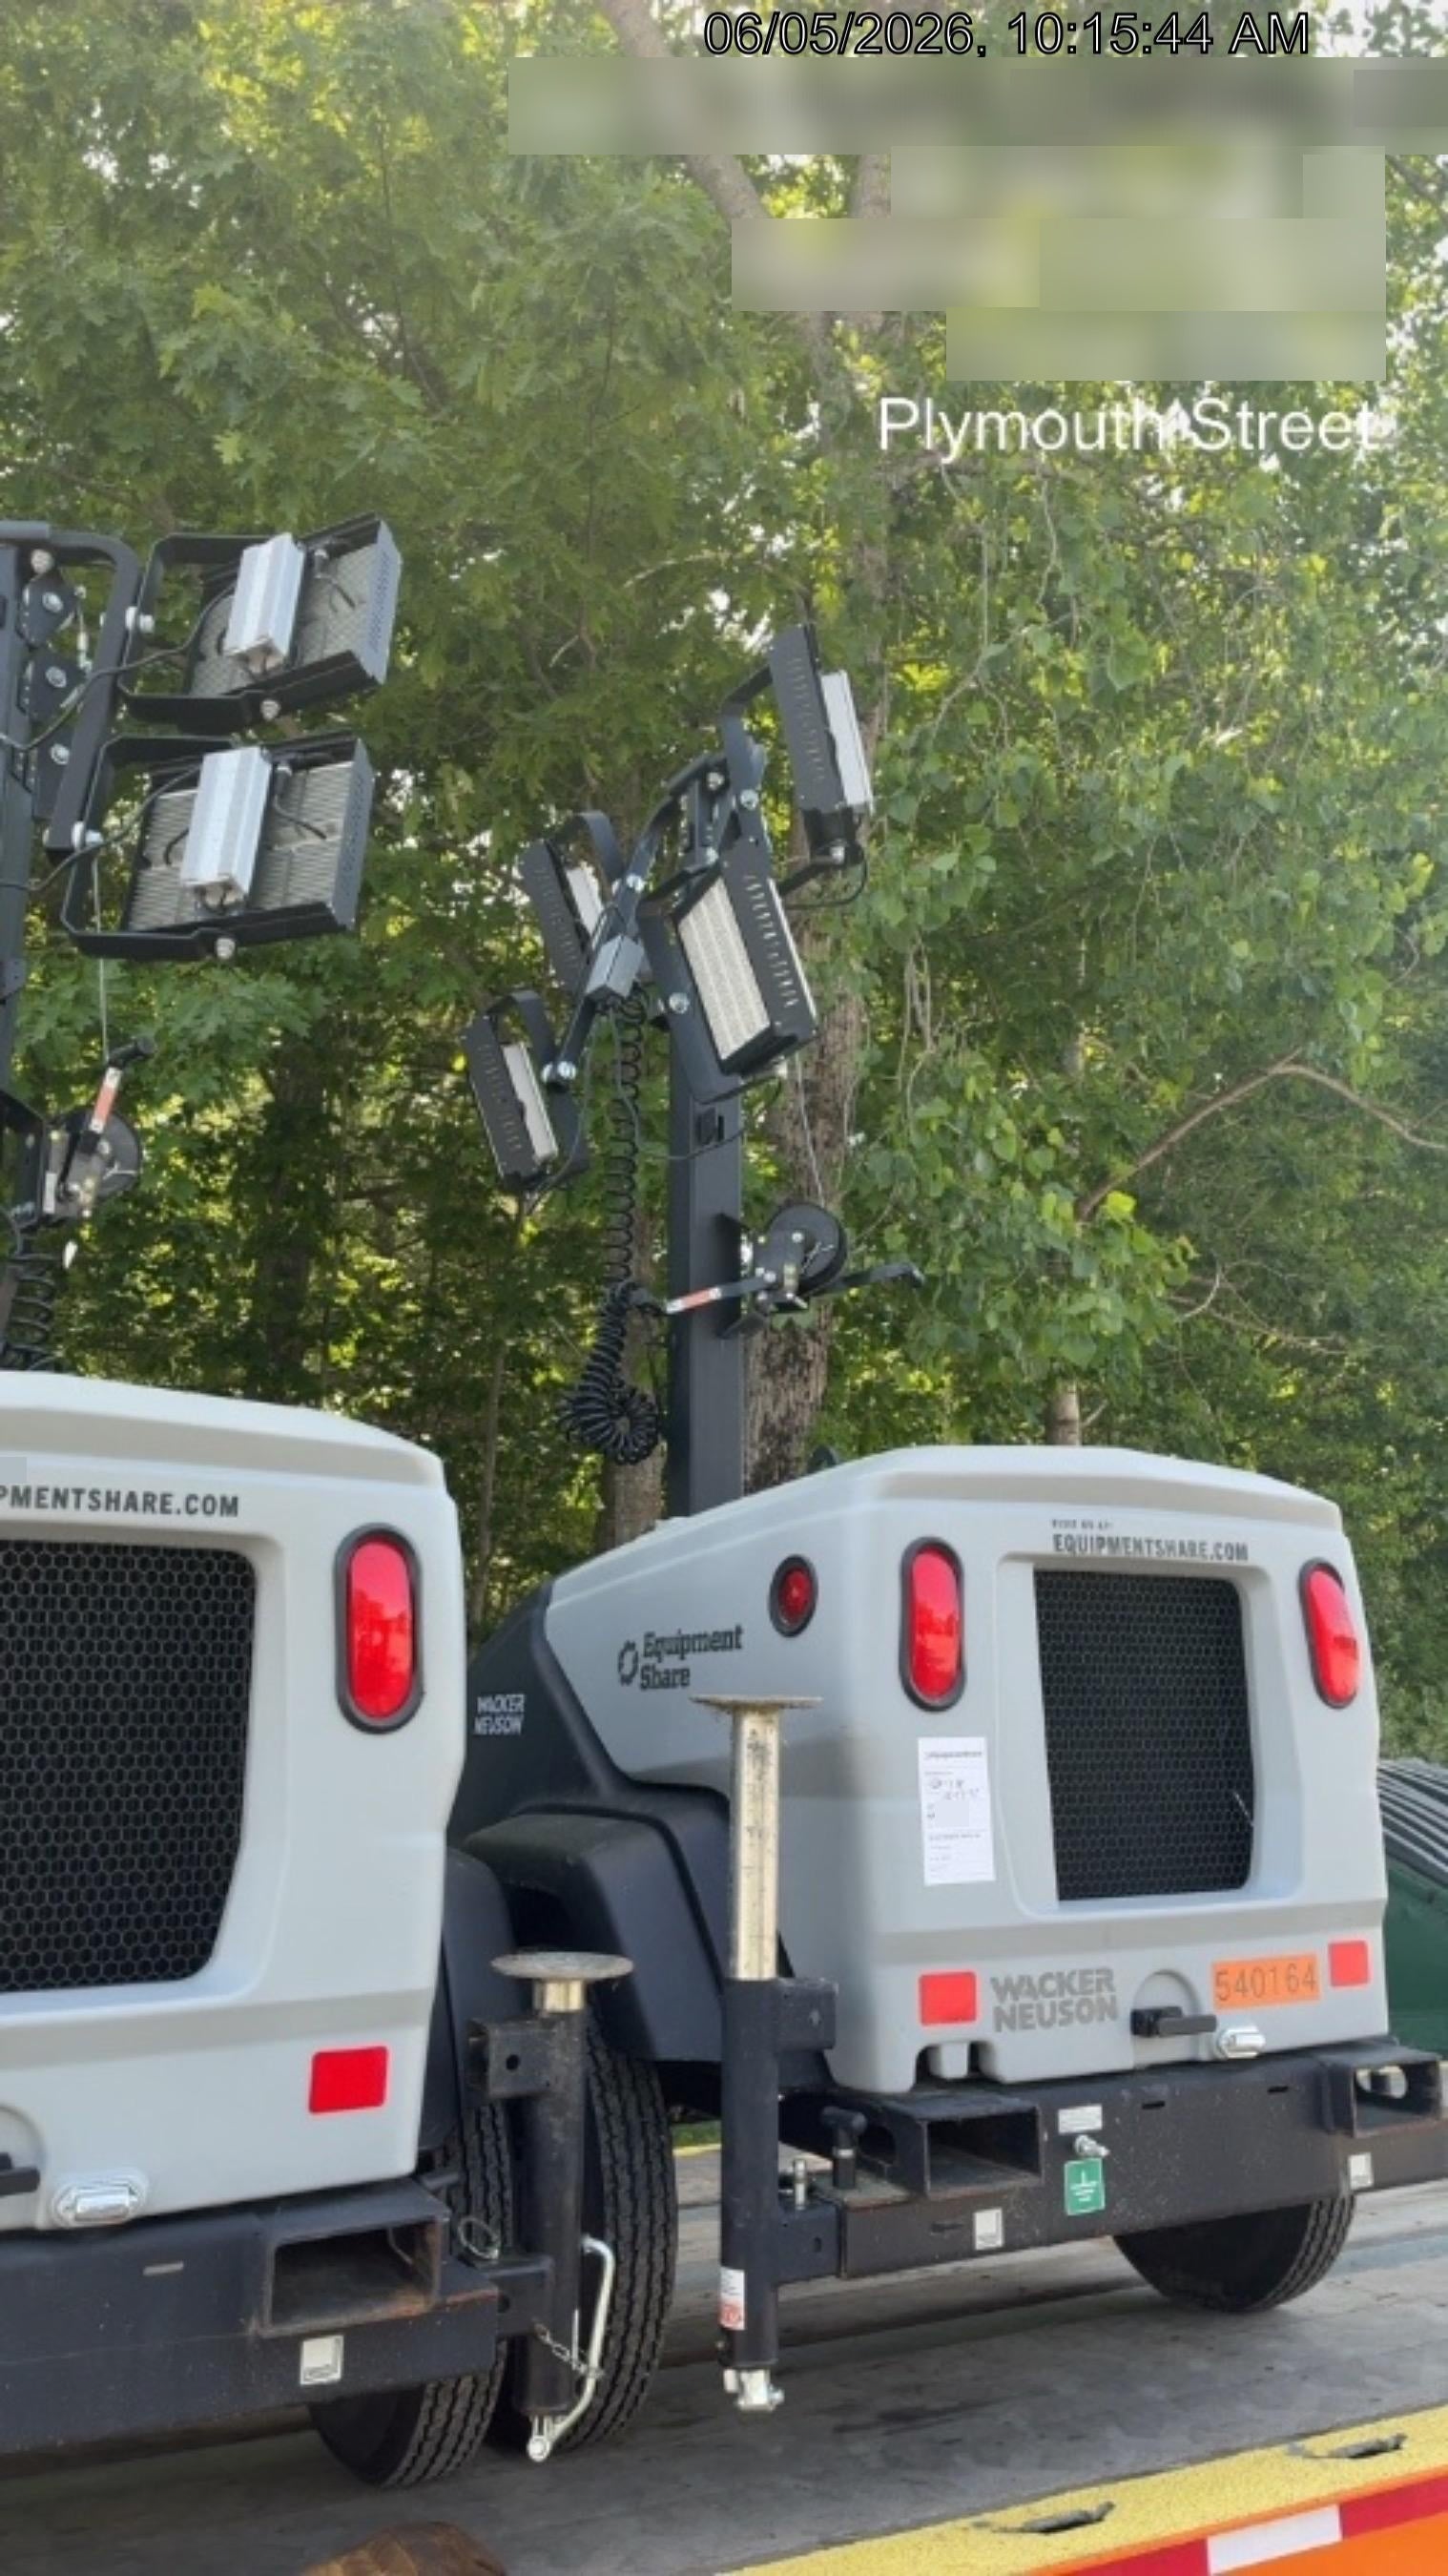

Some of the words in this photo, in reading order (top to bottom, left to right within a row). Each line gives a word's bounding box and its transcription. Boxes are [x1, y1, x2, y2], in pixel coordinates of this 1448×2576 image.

[1052, 1532, 1249, 1562] EQUIPMENTSHARE.COM
[642, 1625, 743, 1662] Equipment
[640, 1664, 691, 1690] Share
[990, 1967, 1115, 2002] WACKER
[1214, 1962, 1317, 2003] 540164
[994, 1995, 1119, 2033] NEUSON
